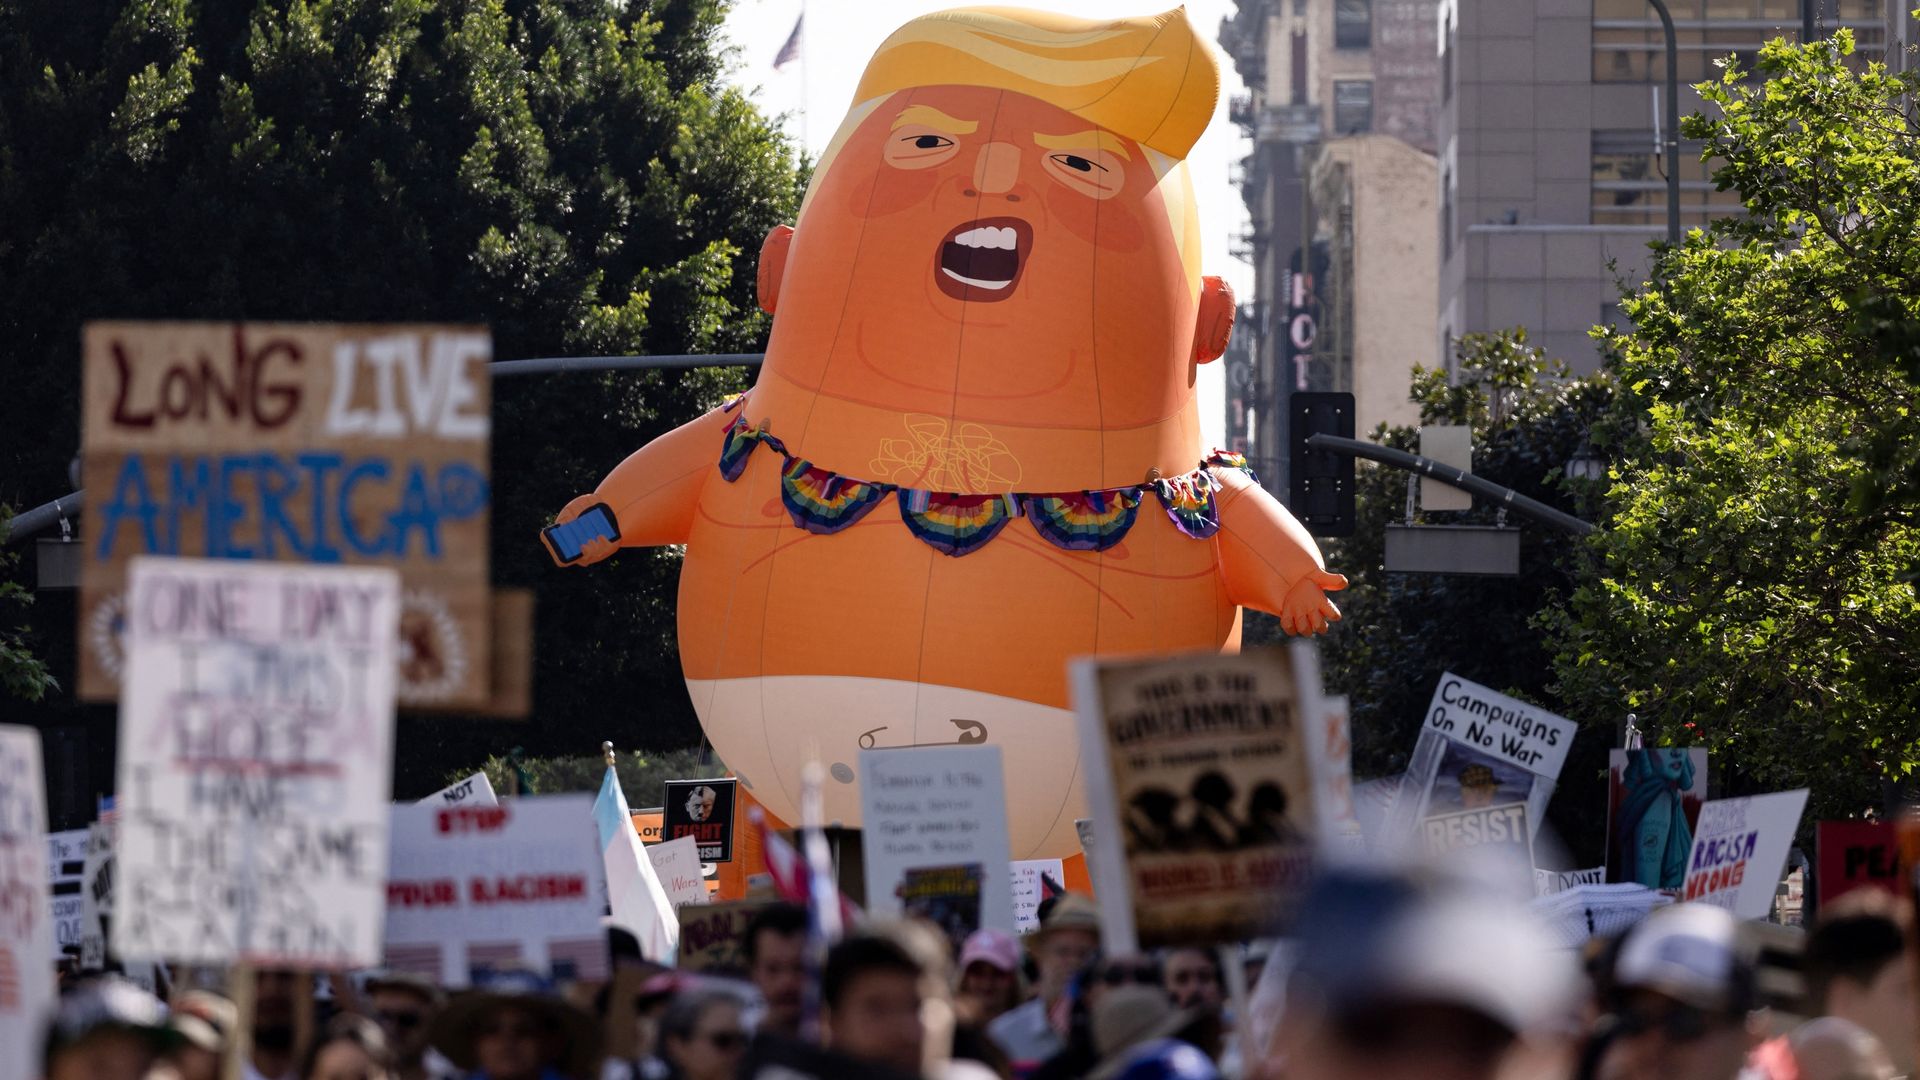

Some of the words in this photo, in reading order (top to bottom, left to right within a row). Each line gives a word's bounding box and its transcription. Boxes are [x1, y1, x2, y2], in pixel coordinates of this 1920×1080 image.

[110, 325, 304, 428] LONG
[327, 332, 491, 438] LIVE
[96, 452, 443, 563] AMERICA
[1442, 681, 1561, 746] Campaigns
[1432, 707, 1454, 731] On
[1466, 721, 1493, 747] No
[1501, 733, 1543, 766] War
[443, 780, 474, 801] NOT
[436, 806, 511, 836] STOP
[673, 823, 723, 840] FIGHT
[1427, 806, 1524, 857] RESIST
[468, 873, 587, 903] RACISM
[671, 875, 698, 892] Wars
[1686, 859, 1746, 901] WRONG
